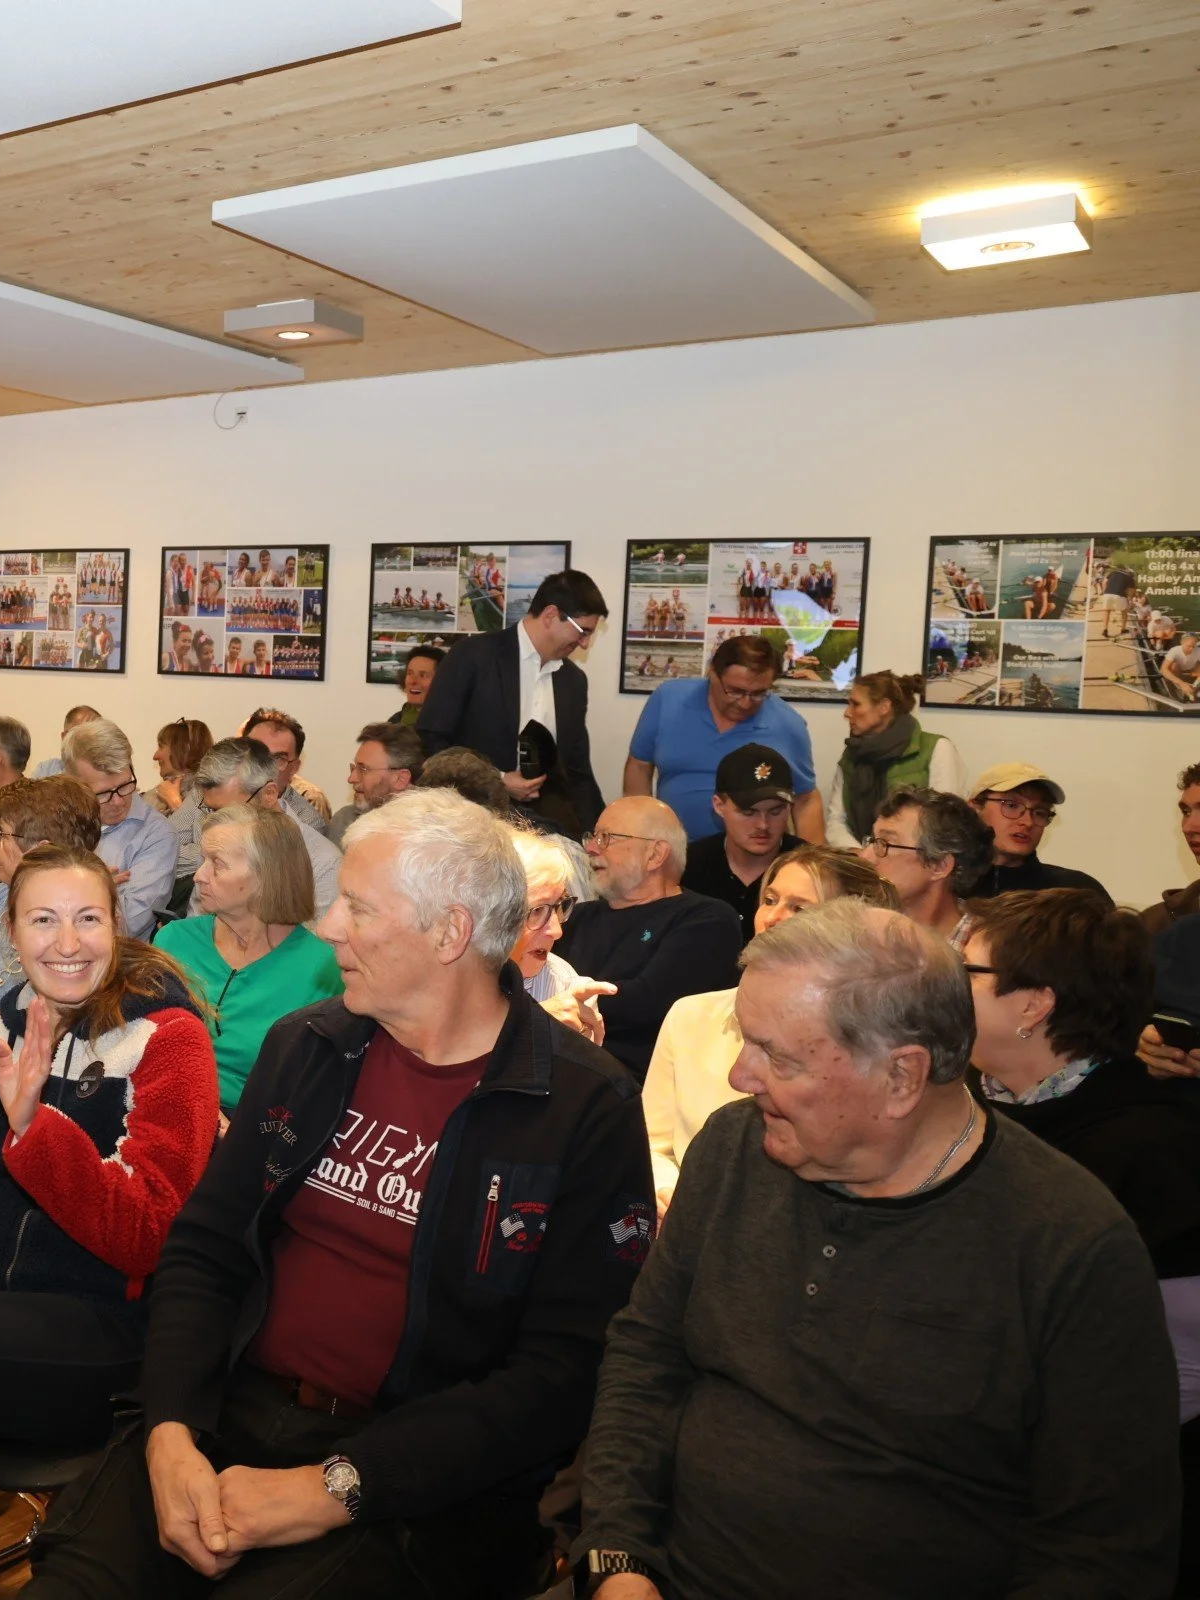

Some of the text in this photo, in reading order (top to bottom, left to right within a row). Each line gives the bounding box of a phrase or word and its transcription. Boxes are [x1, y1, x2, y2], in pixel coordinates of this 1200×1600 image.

[1144, 549, 1174, 559] 11:00
[1148, 561, 1194, 571] Girls 4x
[1137, 574, 1181, 586] Hadley
[1145, 586, 1188, 596] Amelie
[310, 1156, 369, 1193] and
[356, 1197, 396, 1219] SOIL & SAND
